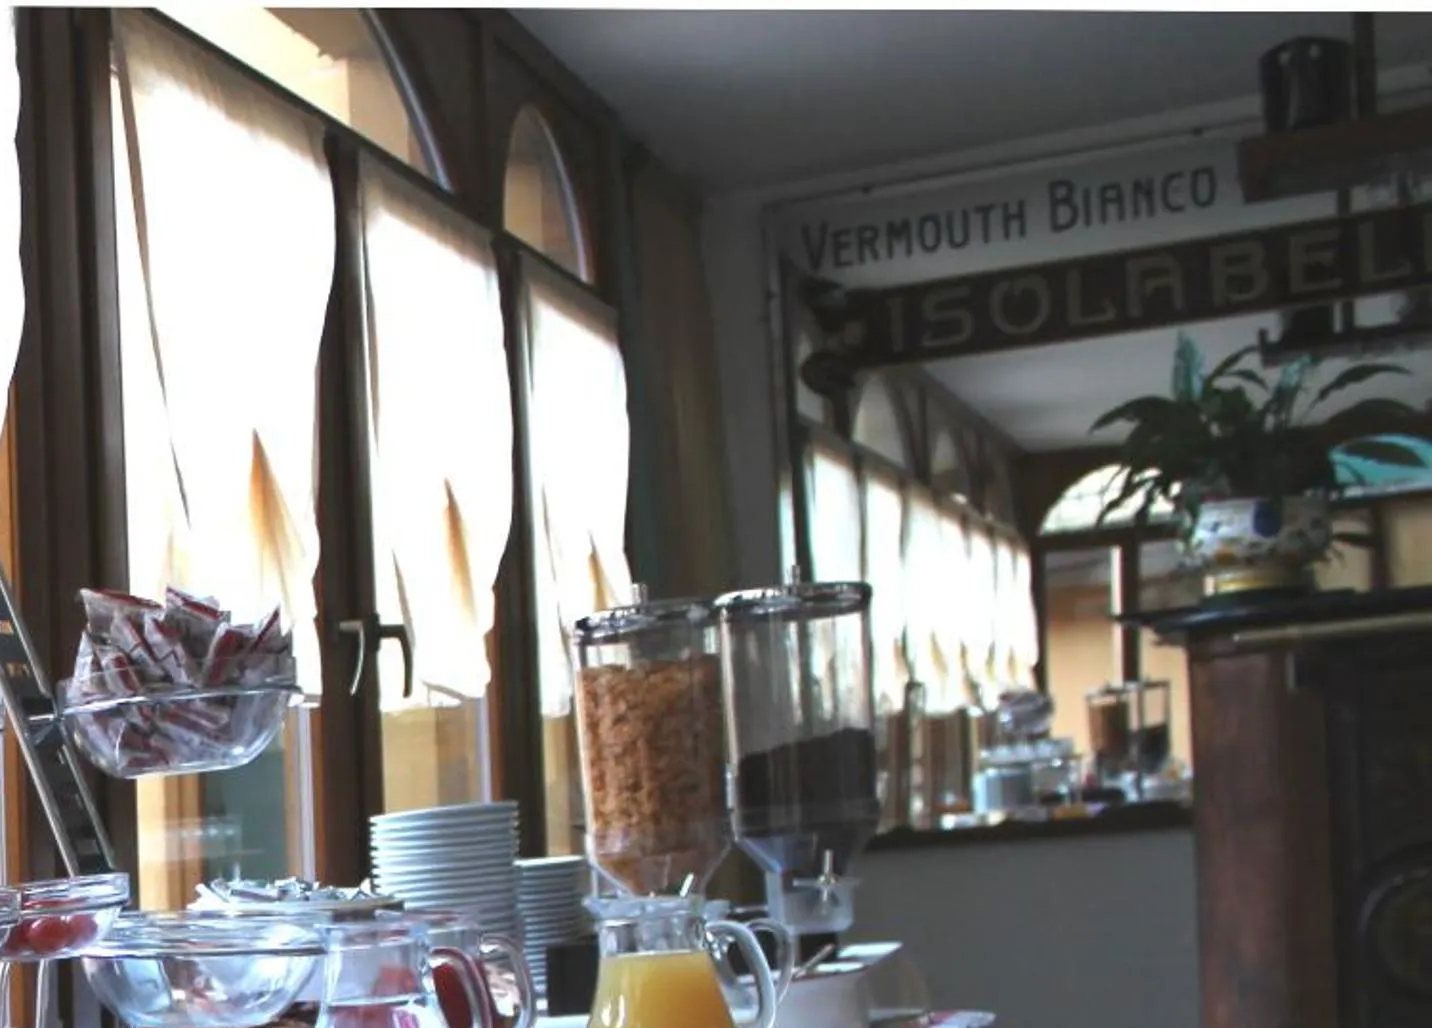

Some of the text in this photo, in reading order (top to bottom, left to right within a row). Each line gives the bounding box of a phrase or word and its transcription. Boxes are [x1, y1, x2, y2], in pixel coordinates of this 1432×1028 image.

[800, 166, 1216, 270] VERMOUTH BIANCO
[886, 213, 1432, 352] ISOLABEL
